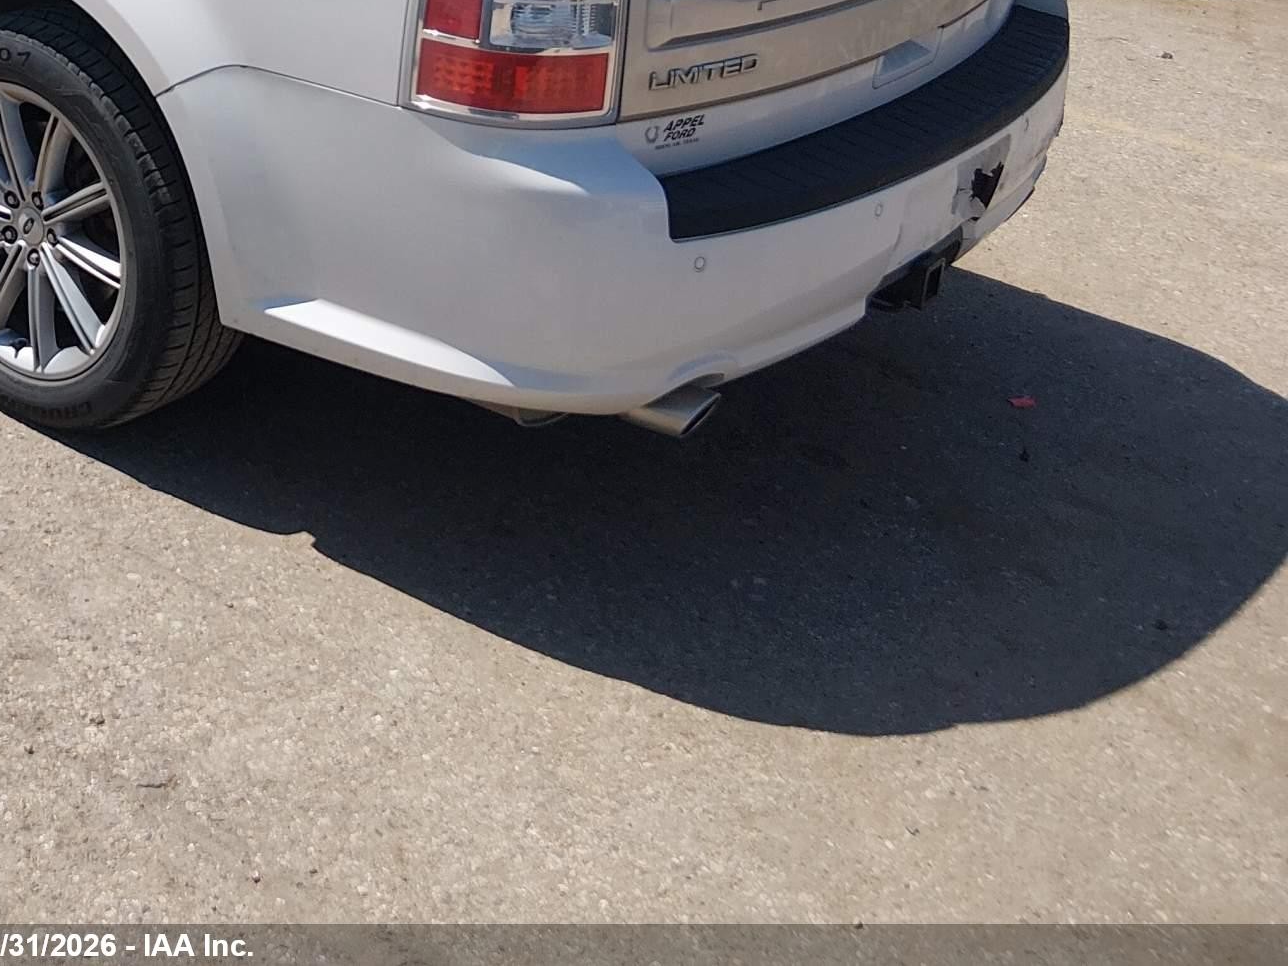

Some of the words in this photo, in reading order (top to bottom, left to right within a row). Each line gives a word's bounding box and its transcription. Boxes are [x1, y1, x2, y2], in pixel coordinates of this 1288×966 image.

[648, 53, 759, 90] LIMITED
[663, 114, 705, 132] APPEL
[663, 127, 697, 141] FORD
